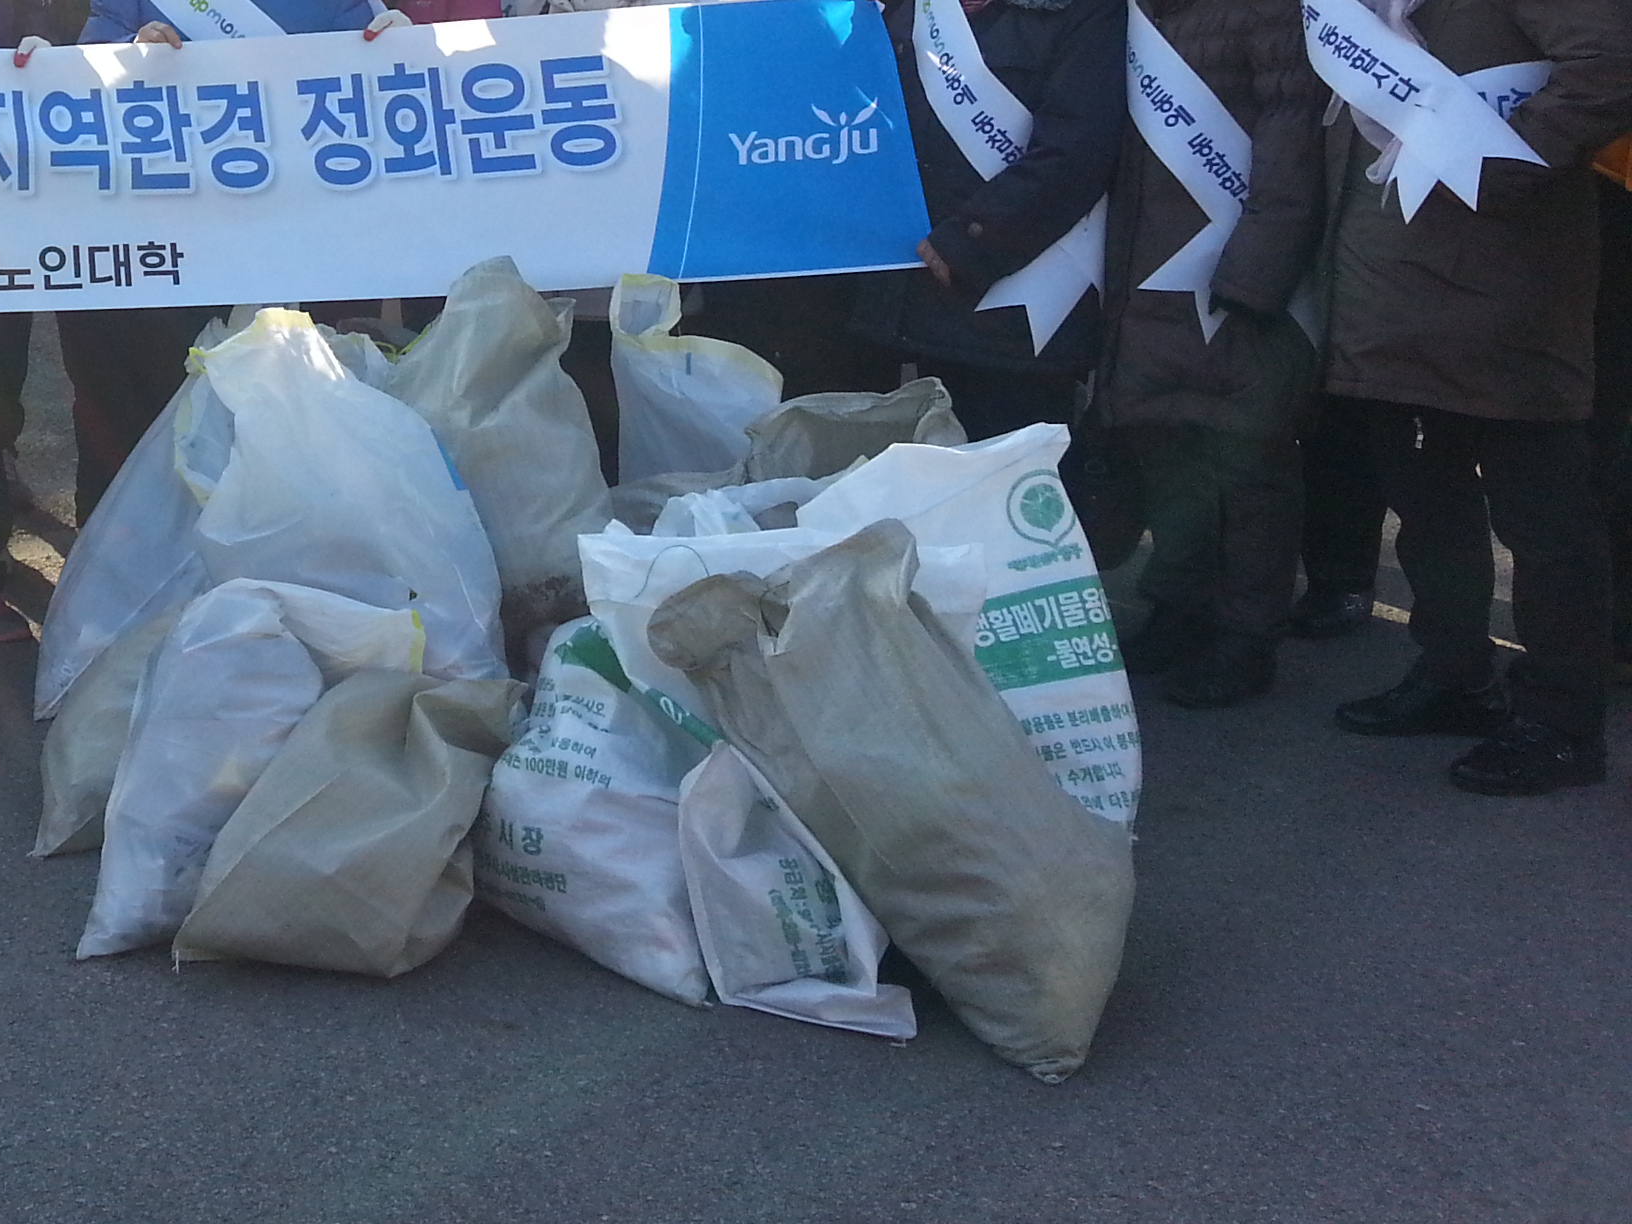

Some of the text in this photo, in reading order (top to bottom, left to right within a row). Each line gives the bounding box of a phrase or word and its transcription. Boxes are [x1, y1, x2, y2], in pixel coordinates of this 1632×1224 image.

[1318, 22, 1420, 102] 동참합시다
[295, 57, 617, 184] 정화운동
[1187, 132, 1248, 199] 동참합
[525, 757, 569, 779] 100만원
[574, 764, 612, 788] 이하의
[521, 826, 544, 856] 장
